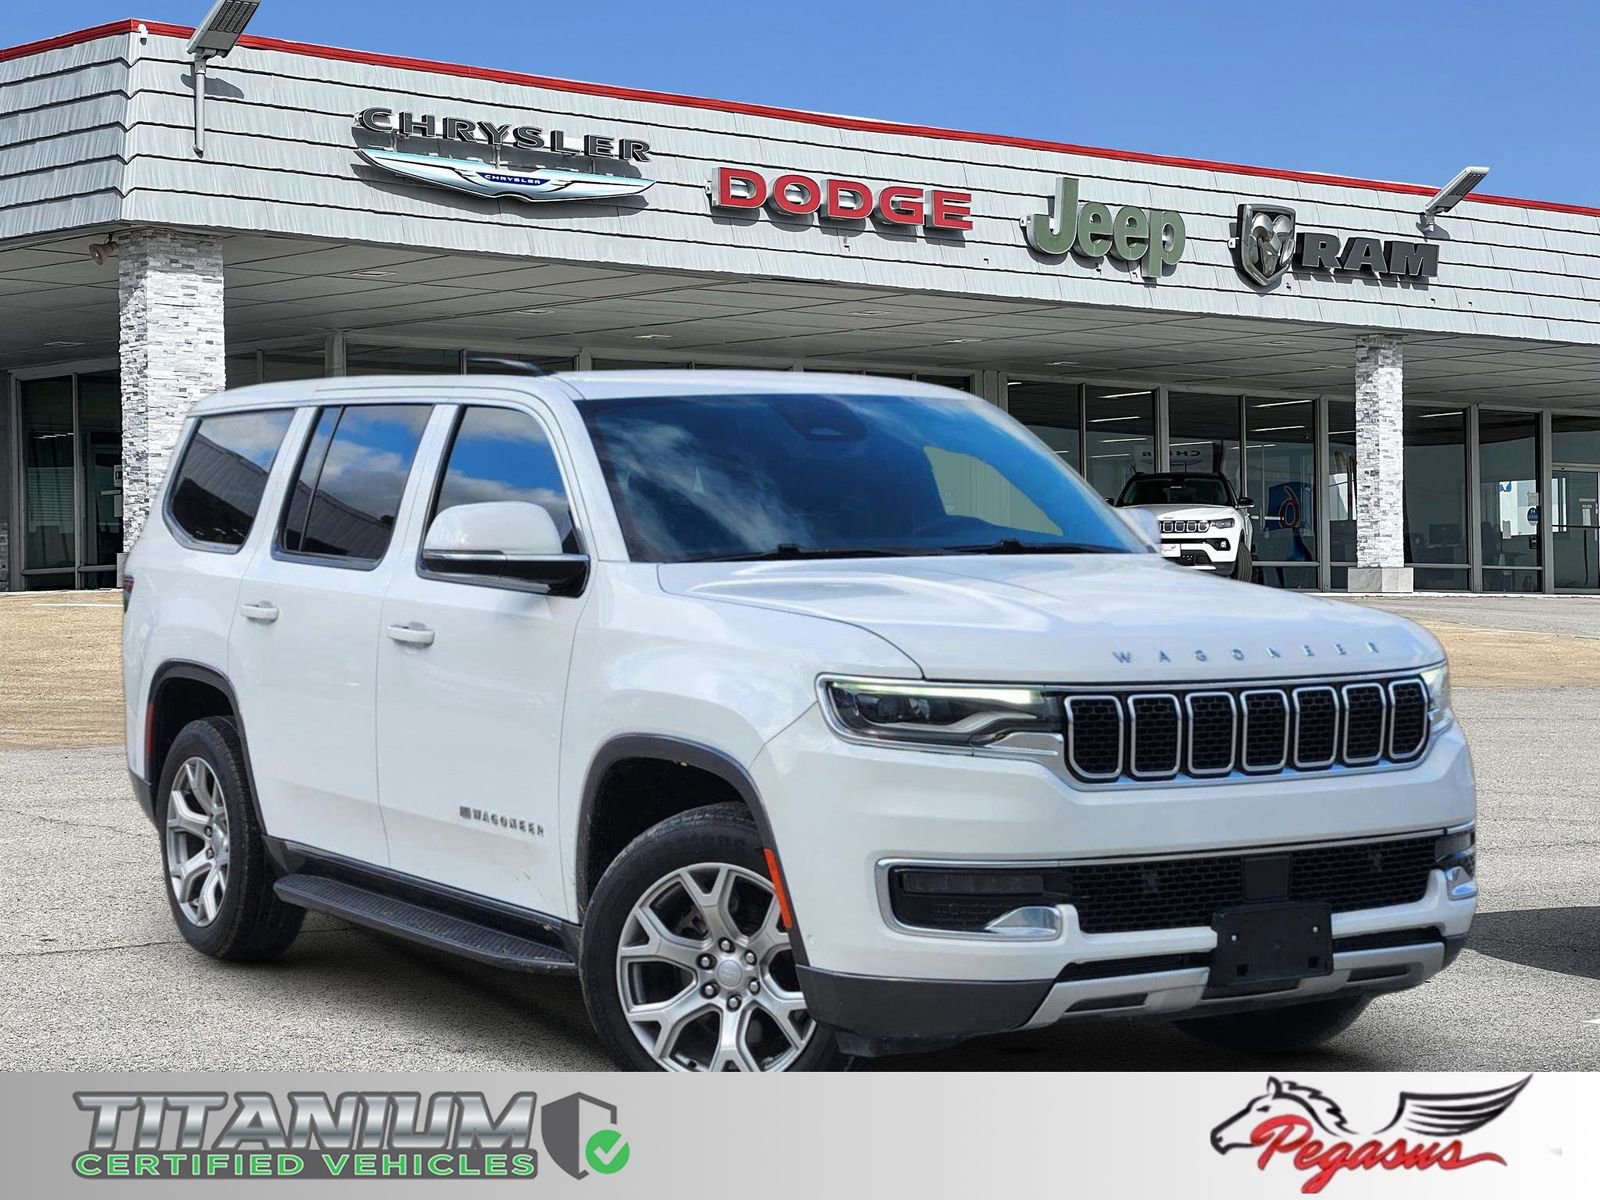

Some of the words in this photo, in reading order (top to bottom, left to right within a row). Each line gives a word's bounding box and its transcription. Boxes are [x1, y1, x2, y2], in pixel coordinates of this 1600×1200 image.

[358, 107, 651, 162] CHRYSLER
[484, 174, 541, 185] CHRYSLER
[712, 167, 973, 231] DODGE
[1027, 177, 1186, 278] Jeep
[1301, 232, 1439, 277] RAM
[1112, 642, 1380, 664] WAGONEER
[472, 808, 545, 837] WAGONEER
